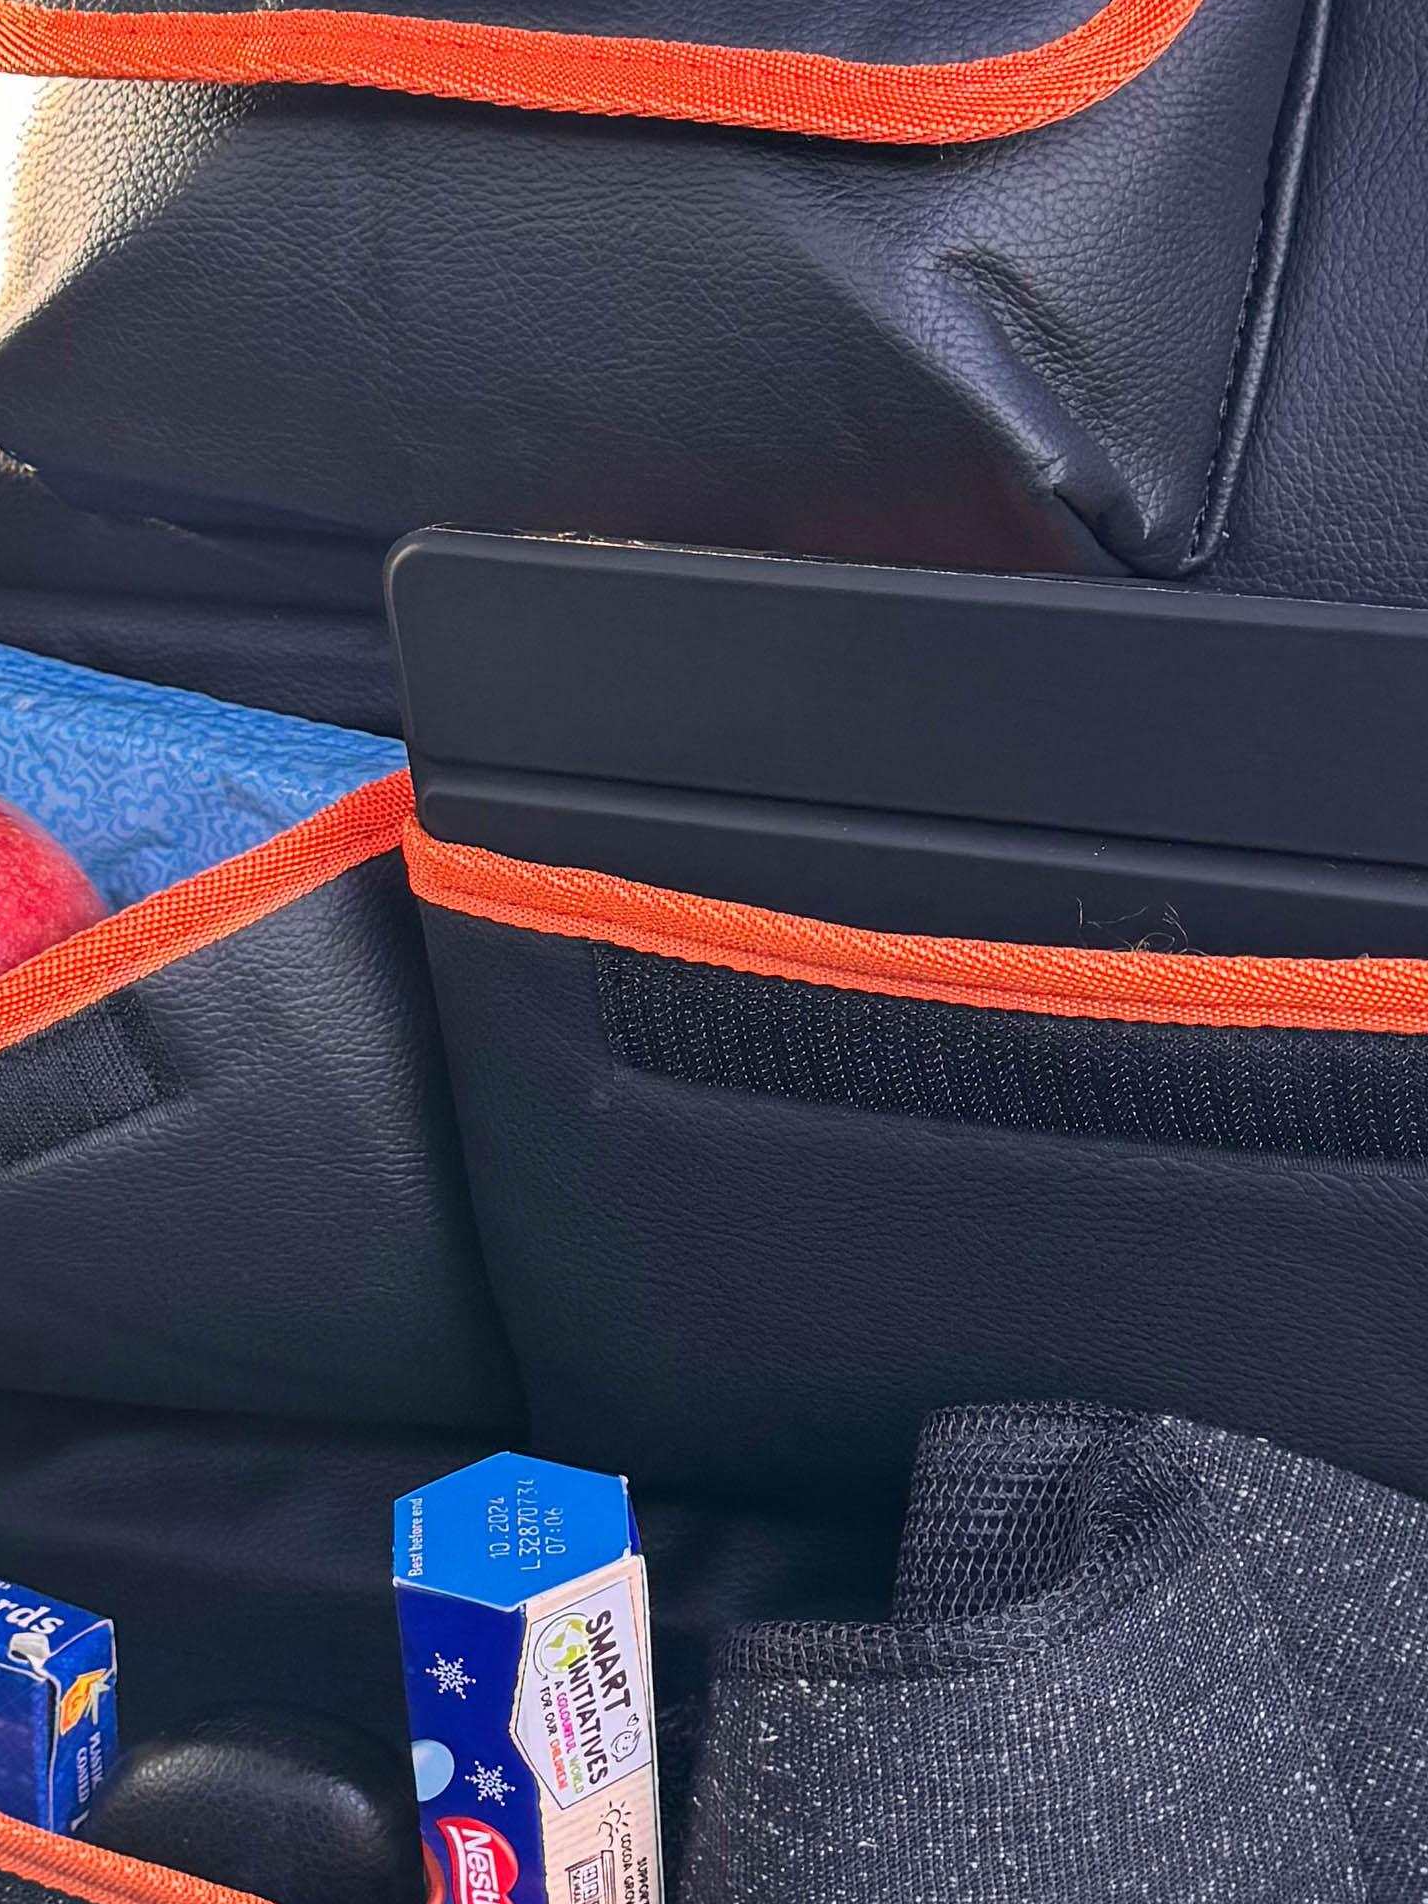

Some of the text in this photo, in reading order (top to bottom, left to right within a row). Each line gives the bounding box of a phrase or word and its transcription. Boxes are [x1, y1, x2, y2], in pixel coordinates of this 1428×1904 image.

[408, 1498, 423, 1577] Best before end
[489, 1496, 511, 1559] 10.2024
[585, 1609, 631, 1713] SMART
[540, 1686, 553, 1710] FOR
[545, 1712, 558, 1736] OUR
[568, 1654, 608, 1785] INITIATIVES
[554, 1680, 584, 1794] A COLOURFUL WORLD
[620, 1833, 633, 1872] COCOA
